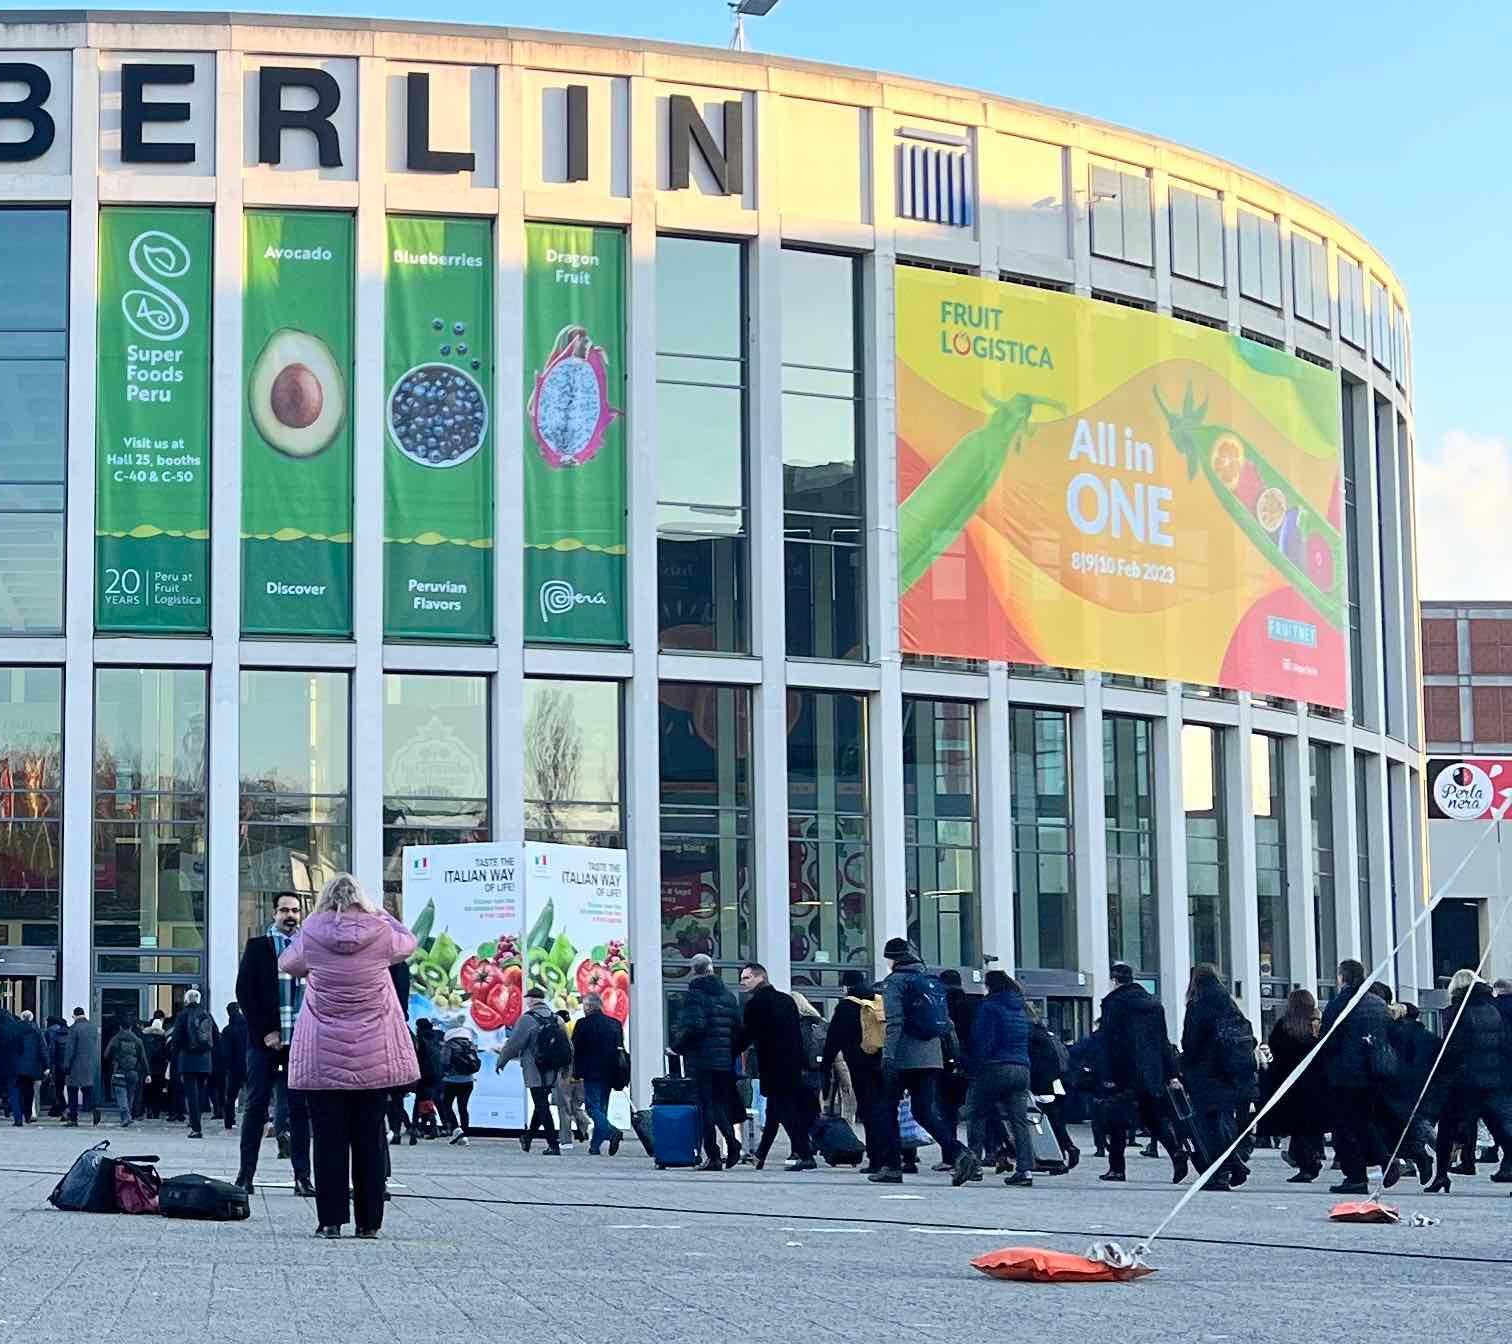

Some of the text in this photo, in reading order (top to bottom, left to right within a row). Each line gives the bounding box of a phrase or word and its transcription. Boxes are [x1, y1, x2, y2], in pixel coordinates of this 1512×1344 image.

[264, 245, 332, 261] Avocado
[393, 250, 483, 268] Blueberries
[545, 249, 600, 268] Dragon
[555, 269, 590, 285] Fruit
[941, 301, 1003, 331] FRUIT
[127, 344, 183, 365] Super
[941, 330, 1054, 370] LOGISTICA
[126, 365, 184, 382] Foods
[126, 384, 172, 402] Peru
[123, 437, 185, 449] Visit us at
[1068, 418, 1155, 474] All in
[106, 453, 201, 467] Hall 25, booths
[113, 470, 194, 483] C-40 & C-50
[1066, 472, 1175, 549] ONE
[154, 571, 193, 582] Peru at
[1117, 559, 1141, 578] Feb
[1143, 561, 1175, 584] 2023
[104, 568, 140, 594] 20
[154, 583, 180, 593] Fruit
[266, 581, 327, 596] Discover
[408, 578, 467, 594] Peruvian
[104, 595, 141, 605] YEARS
[154, 595, 202, 607] Logistica
[413, 596, 462, 611] Flavors
[1441, 783, 1483, 798] Perla
[1447, 798, 1480, 809] nera
[444, 868, 514, 883] ITALIAN WAY
[561, 870, 622, 887] ITALIAN WAY
